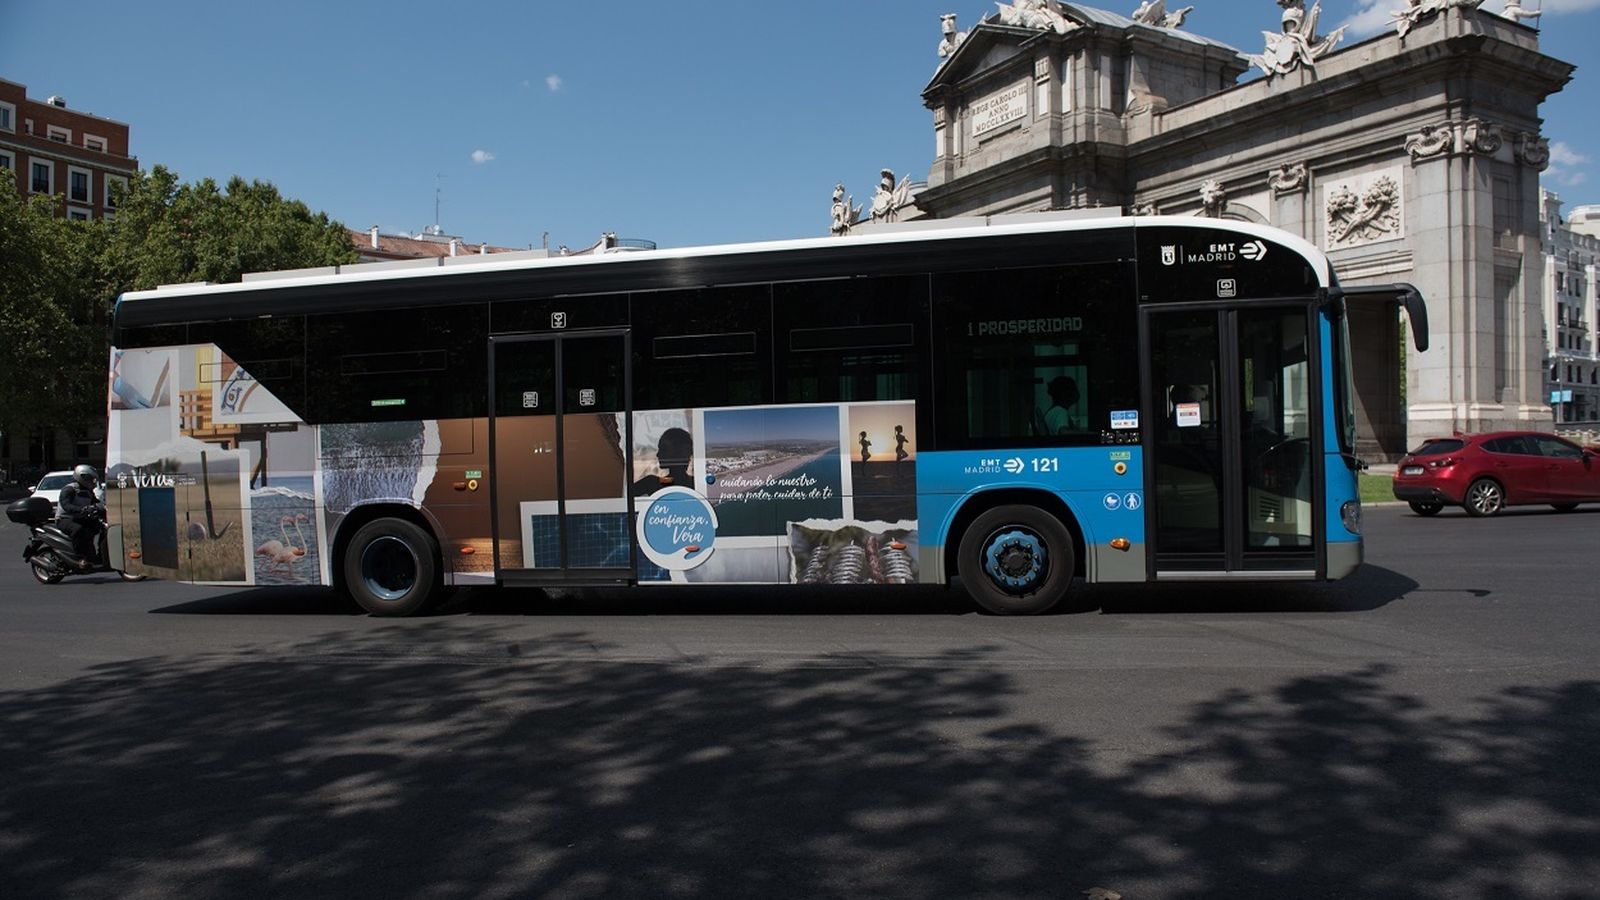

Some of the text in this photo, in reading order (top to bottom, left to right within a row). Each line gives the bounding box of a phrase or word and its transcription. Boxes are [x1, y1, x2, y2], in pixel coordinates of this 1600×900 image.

[990, 90, 1017, 108] CAROLO
[989, 103, 1009, 118] ANNO
[1209, 243, 1235, 253] EMT
[1187, 252, 1236, 262] MADRID
[978, 317, 1083, 336] PROSPERIDAD
[964, 466, 1001, 474] MADRID
[981, 459, 1000, 467] EMT
[1031, 457, 1059, 472] 121
[131, 467, 168, 488] Vera
[720, 473, 817, 487] cuidando lo nuestro
[718, 486, 833, 504] para poder cuidar de ti
[653, 504, 669, 514] en
[648, 514, 709, 530] confianza,
[672, 526, 704, 545] Vera
